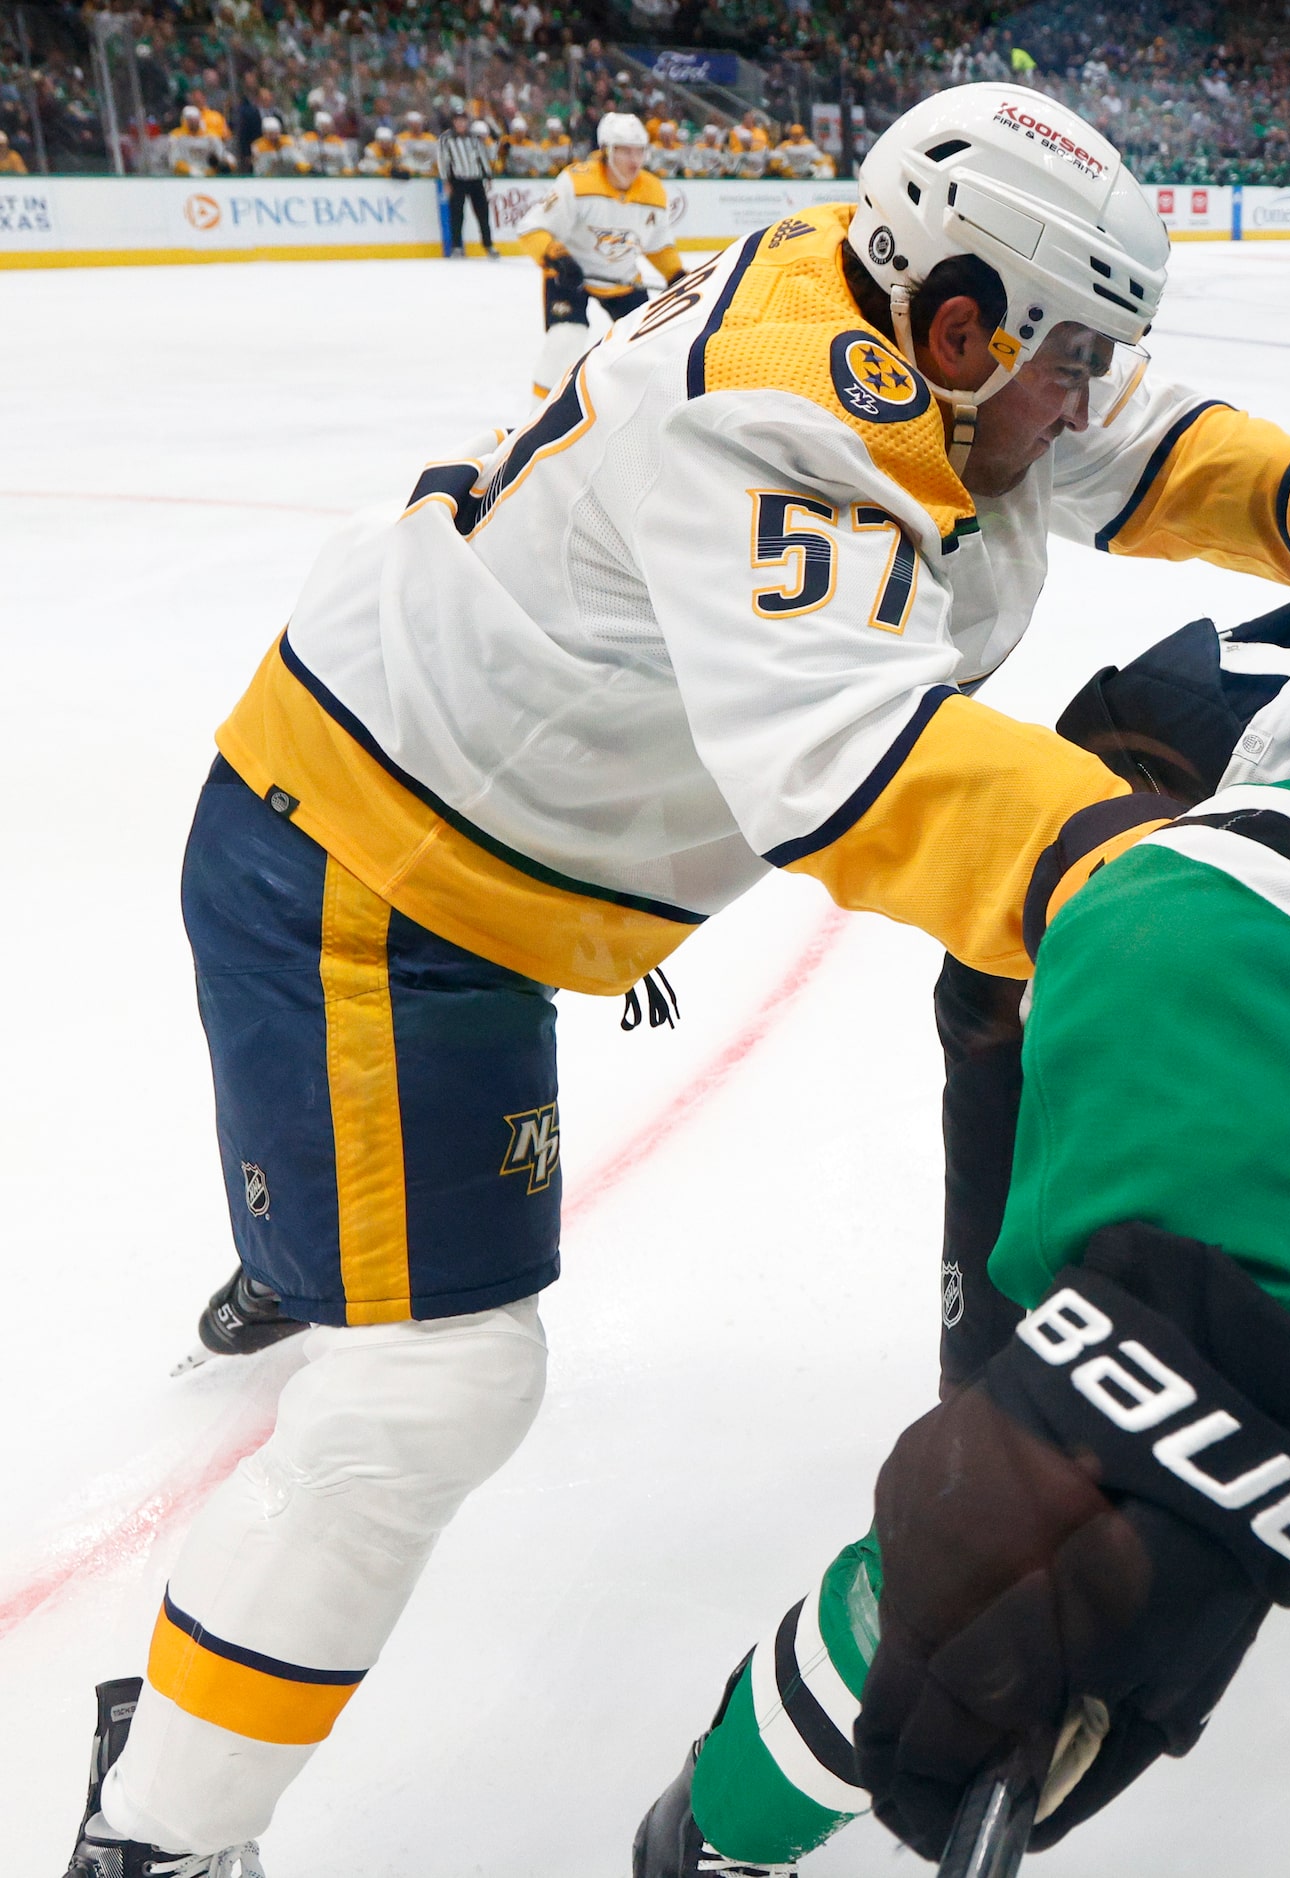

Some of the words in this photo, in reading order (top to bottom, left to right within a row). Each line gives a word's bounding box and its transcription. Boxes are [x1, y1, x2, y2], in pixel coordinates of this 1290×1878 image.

[993, 115, 1021, 132] FIRE
[1025, 131, 1035, 140] &
[998, 102, 1103, 174] Koorsen
[229, 196, 304, 225] PNC
[311, 196, 408, 224] BANK
[645, 211, 657, 225] A
[767, 218, 793, 250] adidas
[745, 488, 920, 636] 57
[217, 1302, 244, 1330] 57
